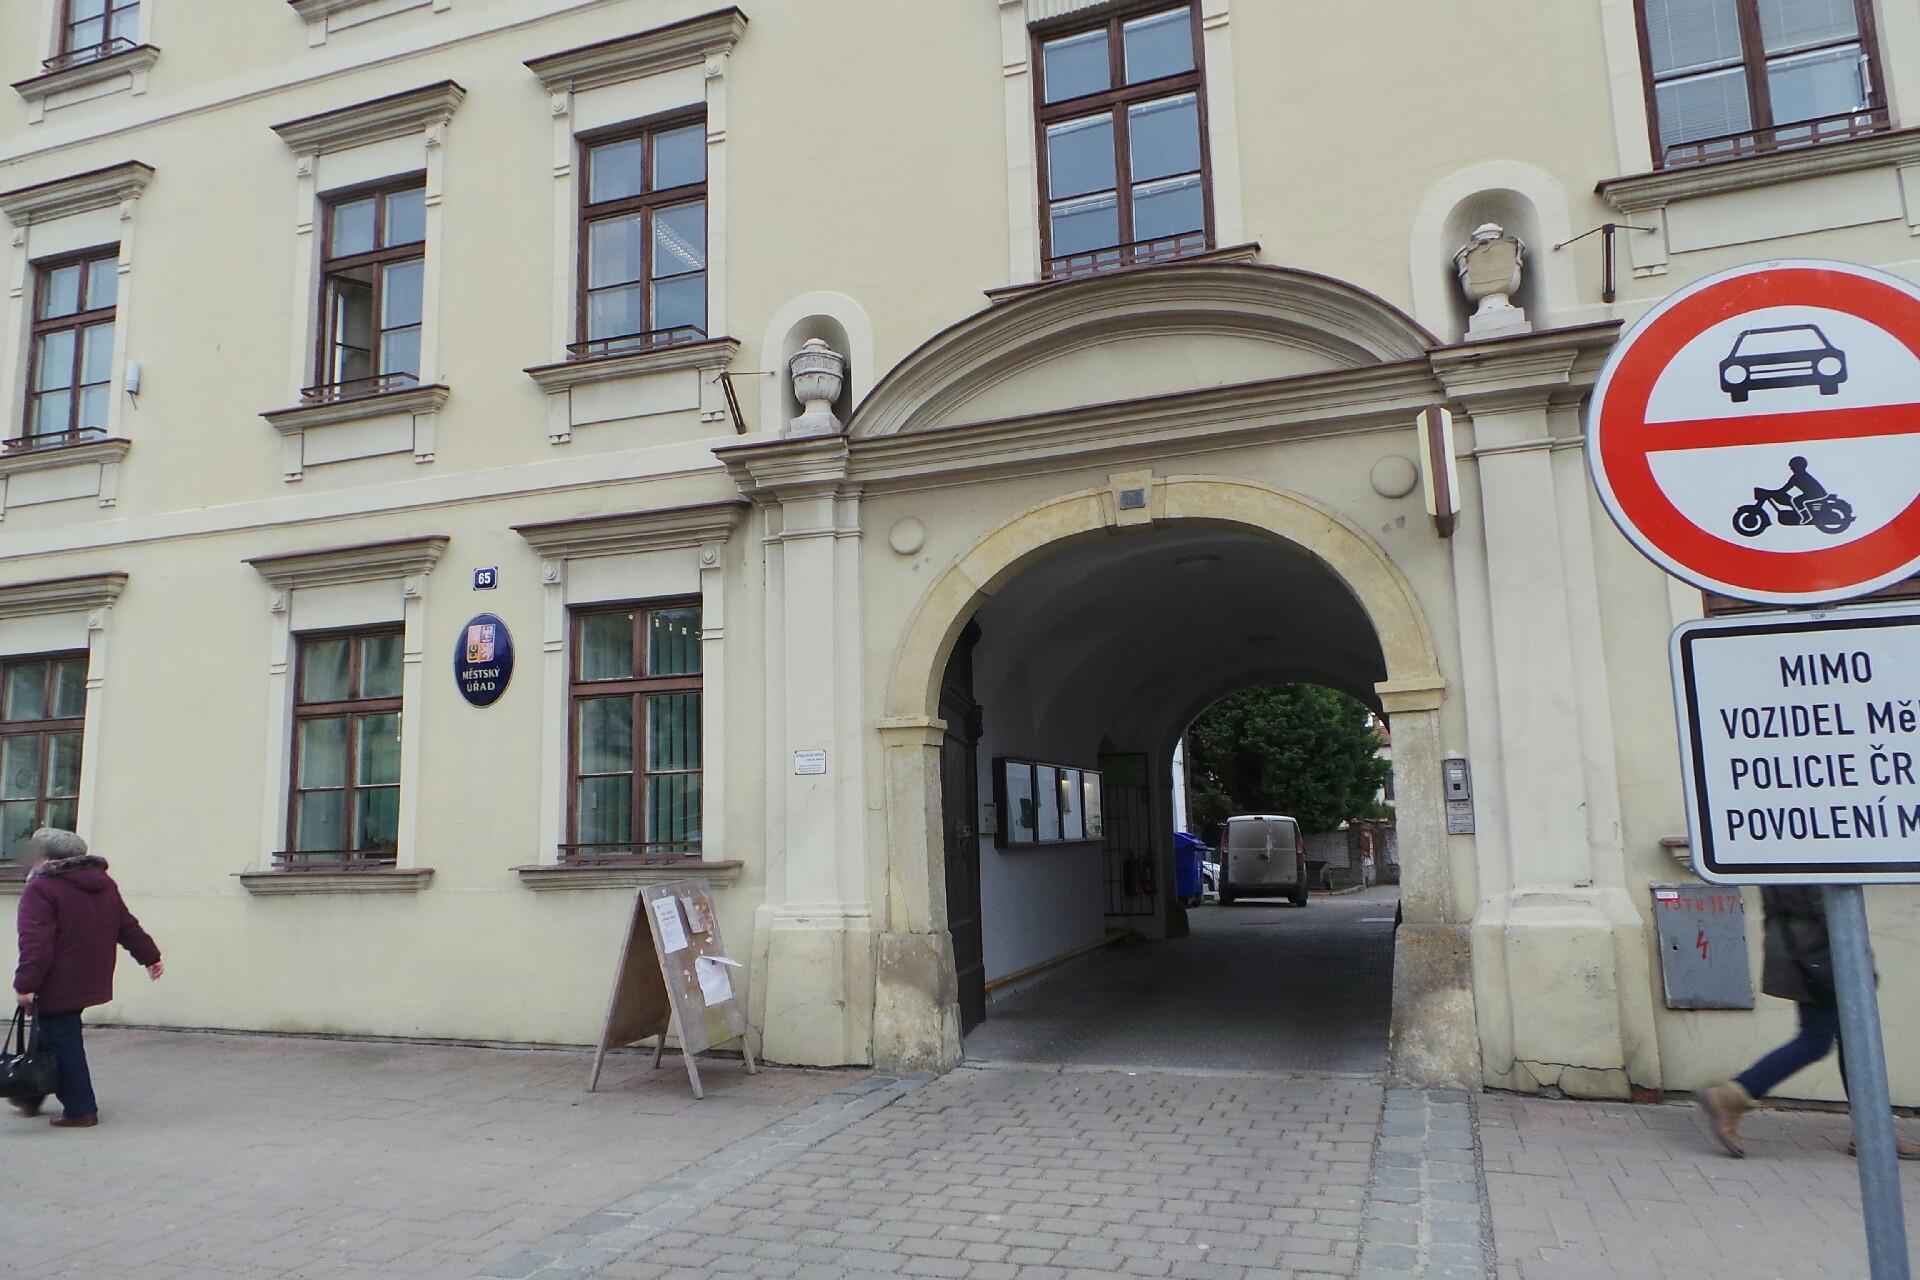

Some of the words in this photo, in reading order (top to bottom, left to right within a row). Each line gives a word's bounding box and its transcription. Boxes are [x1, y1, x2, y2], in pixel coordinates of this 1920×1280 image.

[478, 572, 491, 585] 65
[462, 665, 501, 681] MĚSTSKÝ
[466, 680, 496, 692] ÚŘAD
[1779, 651, 1873, 688] MIMO
[1719, 703, 1855, 740] VOZIDEL
[1866, 699, 1920, 735] Mě
[1731, 753, 1859, 790] POLICIE
[1869, 743, 1917, 786] ČR
[1726, 796, 1889, 841] POVOLENÍ
